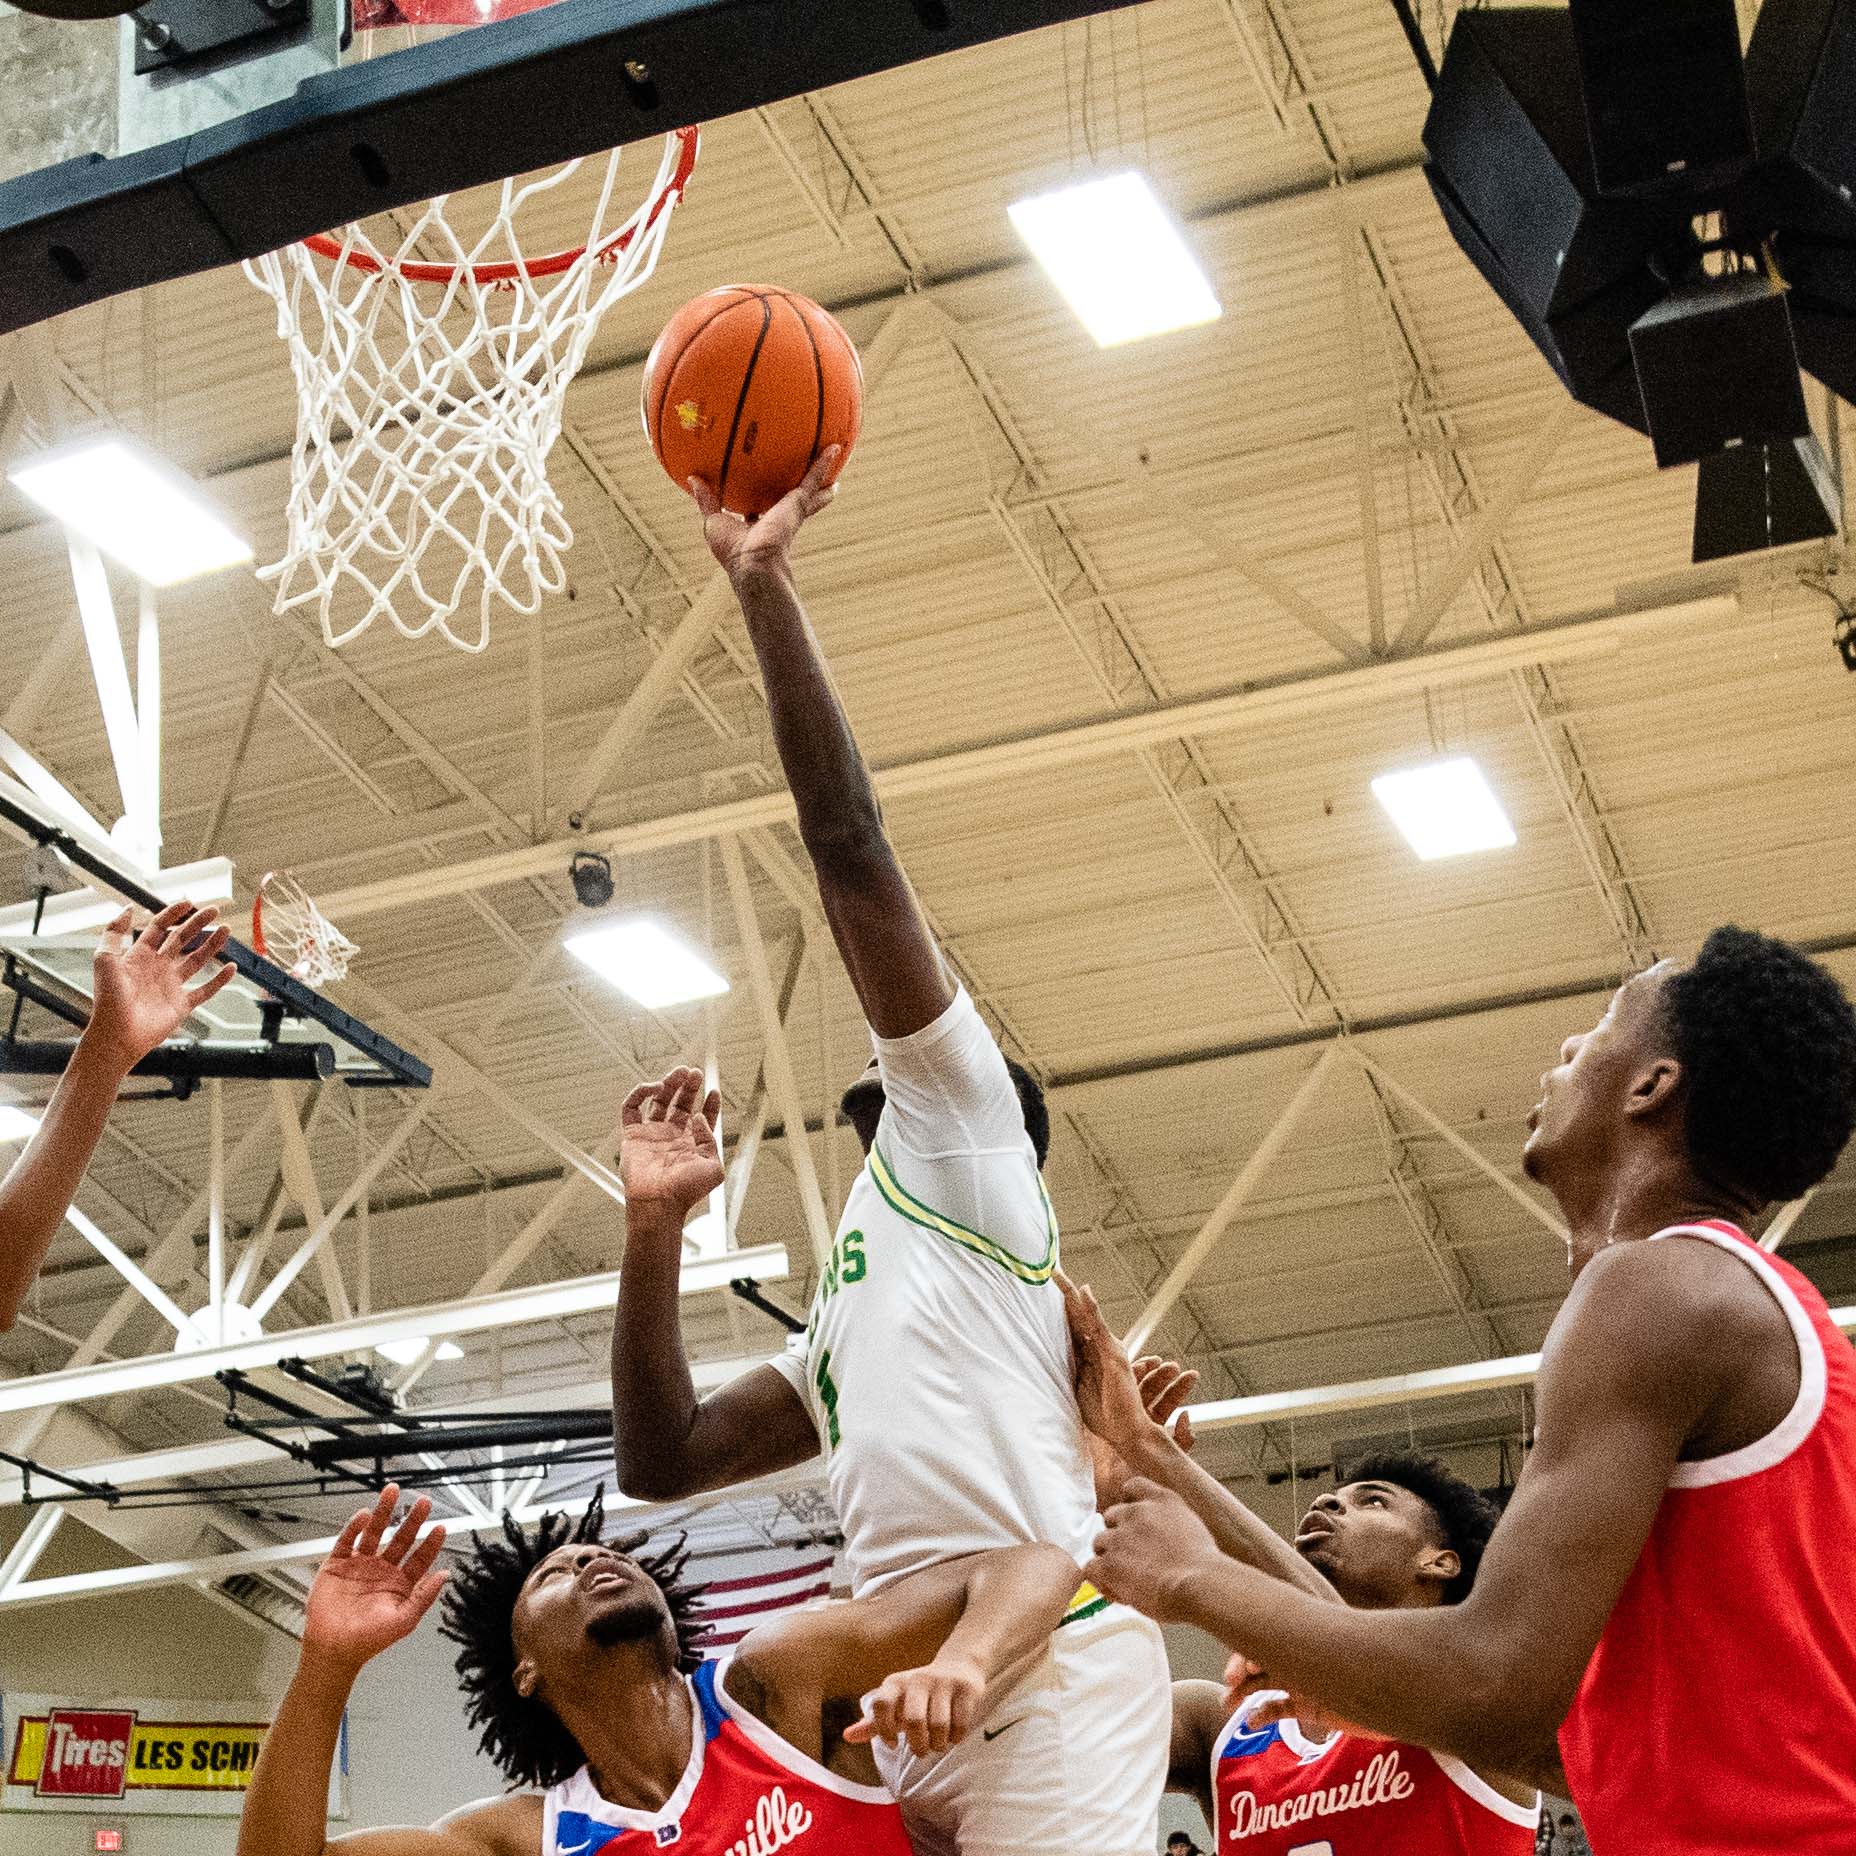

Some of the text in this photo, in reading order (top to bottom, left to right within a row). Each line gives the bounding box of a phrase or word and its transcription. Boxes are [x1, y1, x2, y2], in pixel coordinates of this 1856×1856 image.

[49, 1722, 127, 1773] Tires
[134, 1739, 186, 1772] LES
[1228, 1749, 1415, 1841] Duncanville
